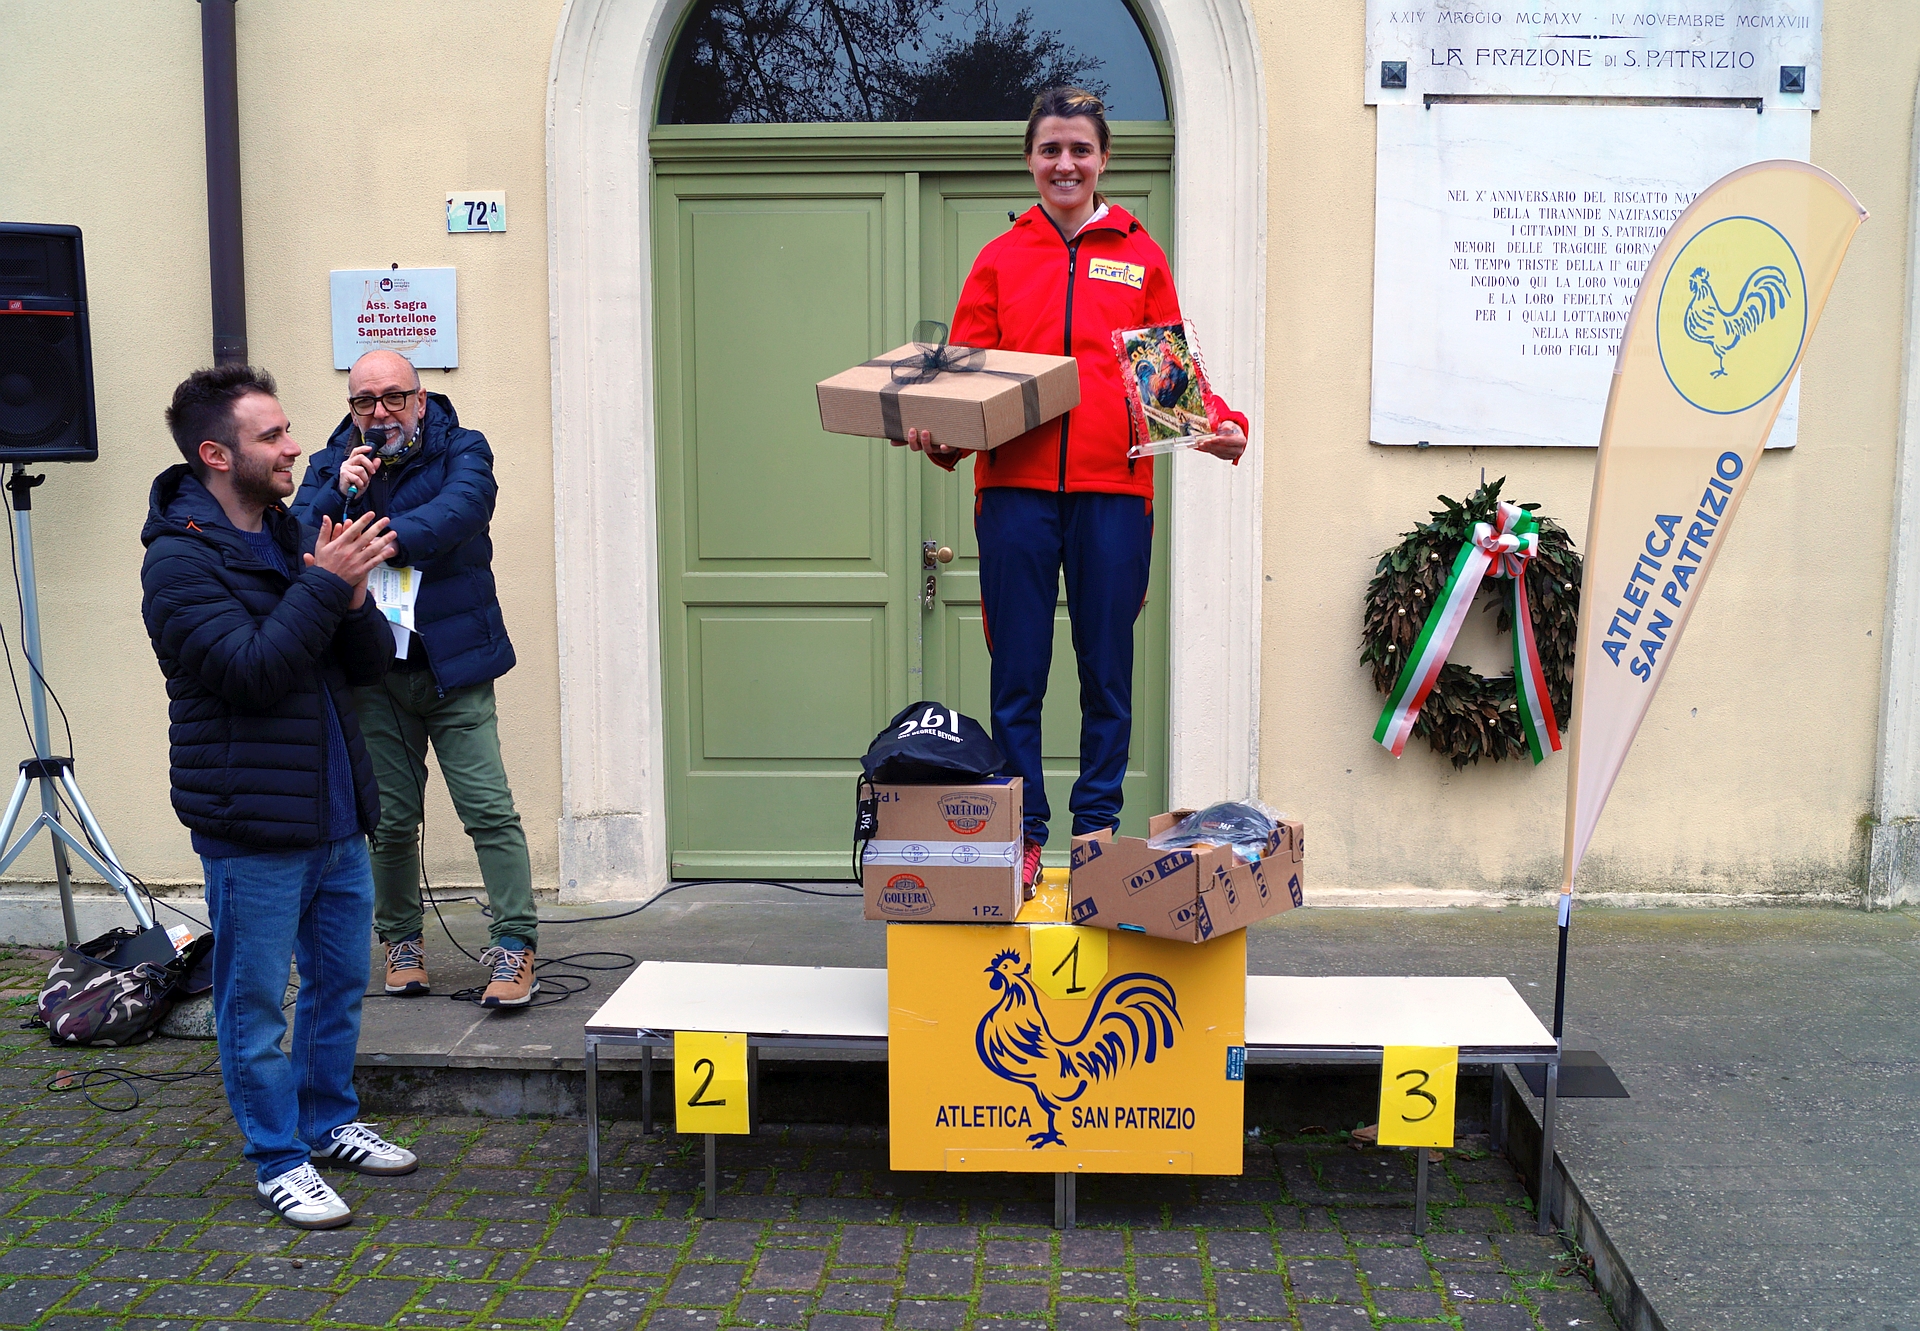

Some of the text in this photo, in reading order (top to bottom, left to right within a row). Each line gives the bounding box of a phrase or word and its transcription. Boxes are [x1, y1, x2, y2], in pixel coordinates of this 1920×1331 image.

[1389, 11, 1809, 29] XXIV MAGGIO MCMXV IV NOVEMBRE MCMXVIII
[1431, 48, 1465, 66] LA
[1475, 48, 1593, 67] FRAZIONE
[1646, 50, 1755, 69] PATRIZIO
[1447, 190, 1469, 202] NEL
[1490, 190, 1576, 203] ANNIVERSARIO
[1583, 191, 1606, 203] DEL
[1614, 191, 1668, 204] RISCATTO
[1674, 192, 1700, 204] NAZ
[1493, 207, 1685, 221] DELLA TIRANNIDE NAZIFASCIST
[1511, 224, 1667, 238] I CITTADINI DI S. PATRIZIO
[1453, 241, 1660, 255] MEMORI DELLE TRAGICHE GIORNA
[1449, 258, 1469, 270] NEL
[1474, 258, 1510, 271] TEMPO
[1516, 258, 1559, 271] TRISTE
[1566, 259, 1604, 272] DELLA
[1626, 260, 1650, 272] GUE
[1471, 275, 1642, 290] INCIDONO QUI LA LORO VOLO
[366, 299, 428, 312] Ass. Sagra
[1488, 292, 1495, 305] E
[1501, 293, 1516, 305] LA
[1525, 293, 1554, 305] LORO
[357, 313, 437, 324] del Tortellone
[1475, 309, 1497, 322] PER
[1508, 310, 1511, 322] I
[1522, 309, 1556, 323] QUALI
[357, 326, 437, 339] Sanpatriziese
[1532, 327, 1623, 340] NELLA RESISTE
[1522, 344, 1525, 356] I
[1533, 344, 1562, 356] LORO
[1569, 344, 1598, 356] FIGLI
[1629, 451, 1744, 683] SAN PATRIZIO
[1601, 514, 1683, 667] ATLETICA
[972, 906, 1003, 916] 1 PZ.
[1052, 936, 1086, 994] 1
[687, 1058, 726, 1107] 2
[1396, 1069, 1437, 1123] 3
[935, 1105, 1195, 1130] ATLETICA SAN PATRIZIO
